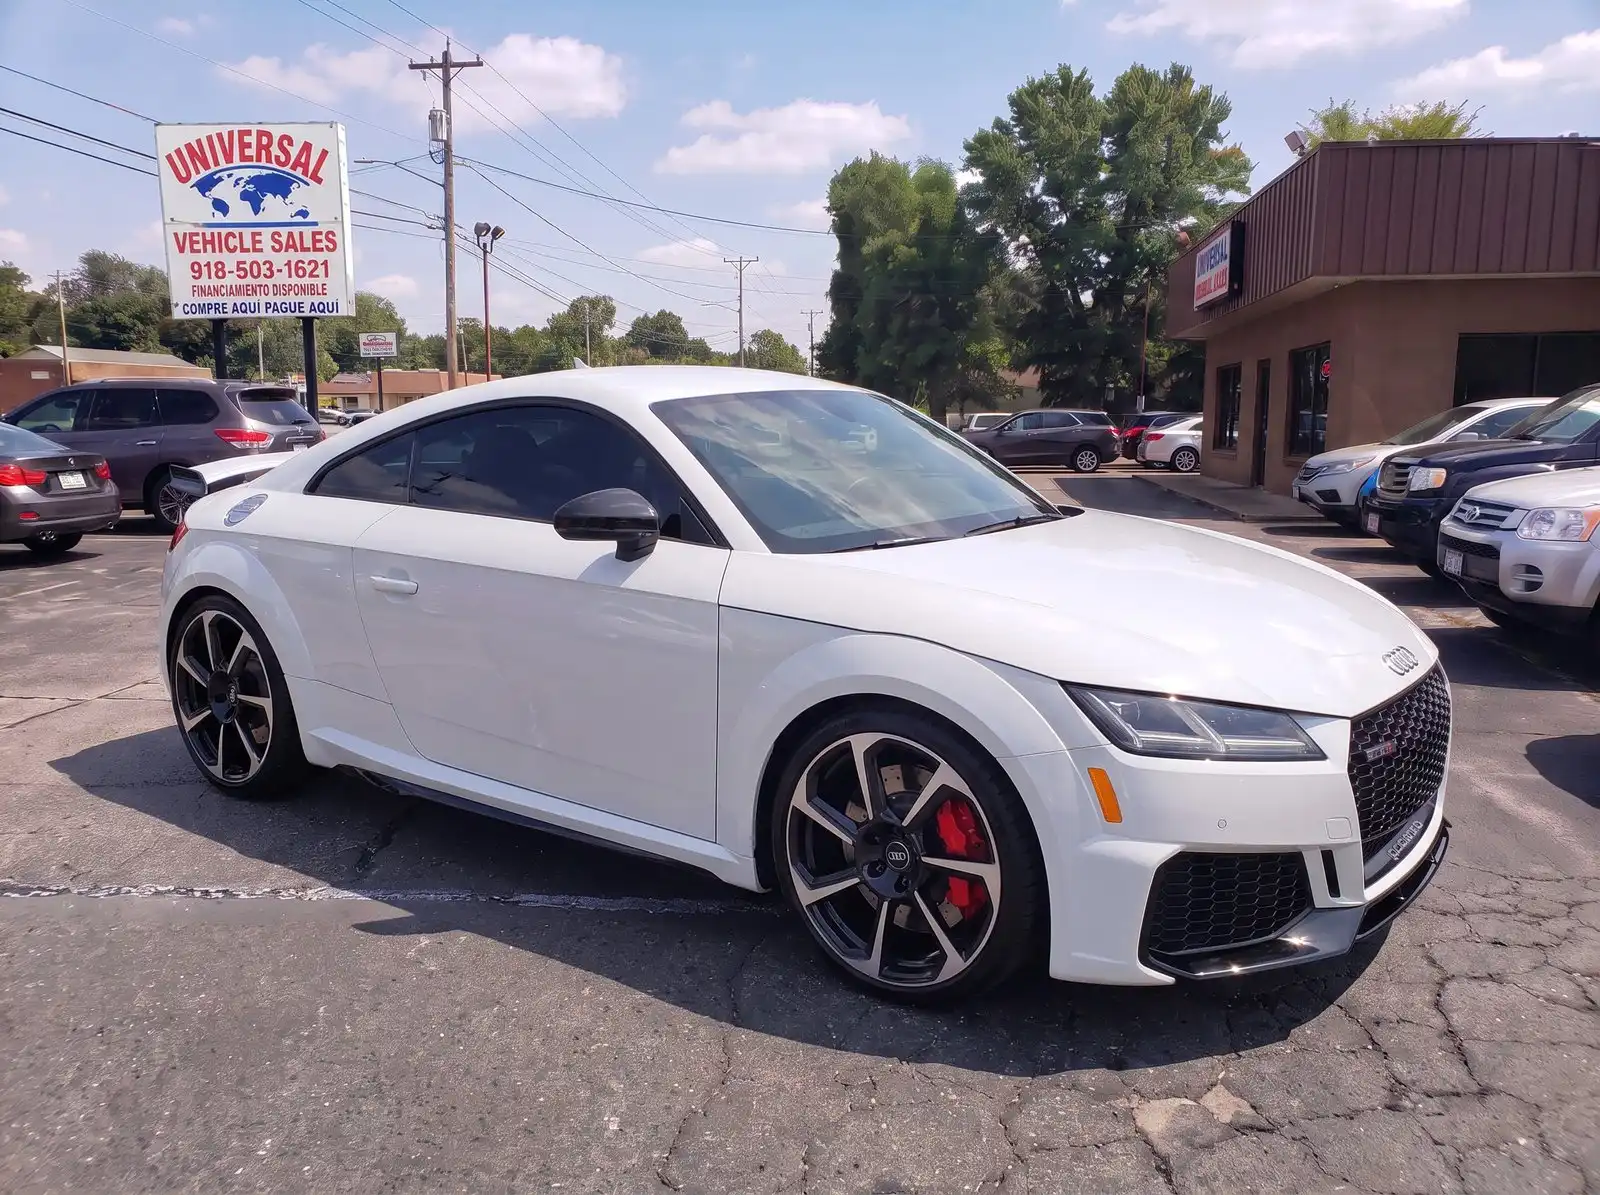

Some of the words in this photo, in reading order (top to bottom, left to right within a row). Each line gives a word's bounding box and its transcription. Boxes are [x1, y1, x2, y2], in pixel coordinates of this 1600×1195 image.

[165, 129, 329, 185] UNIVERSAL
[174, 231, 264, 254] VEHICLE
[270, 230, 338, 253] SALES
[190, 259, 329, 280] 918-503-1621
[191, 284, 270, 298] FINANCIAMIENTO
[272, 283, 328, 297] DISPONIBLE
[182, 301, 229, 315] COMPRE
[265, 301, 305, 313] PAGUE
